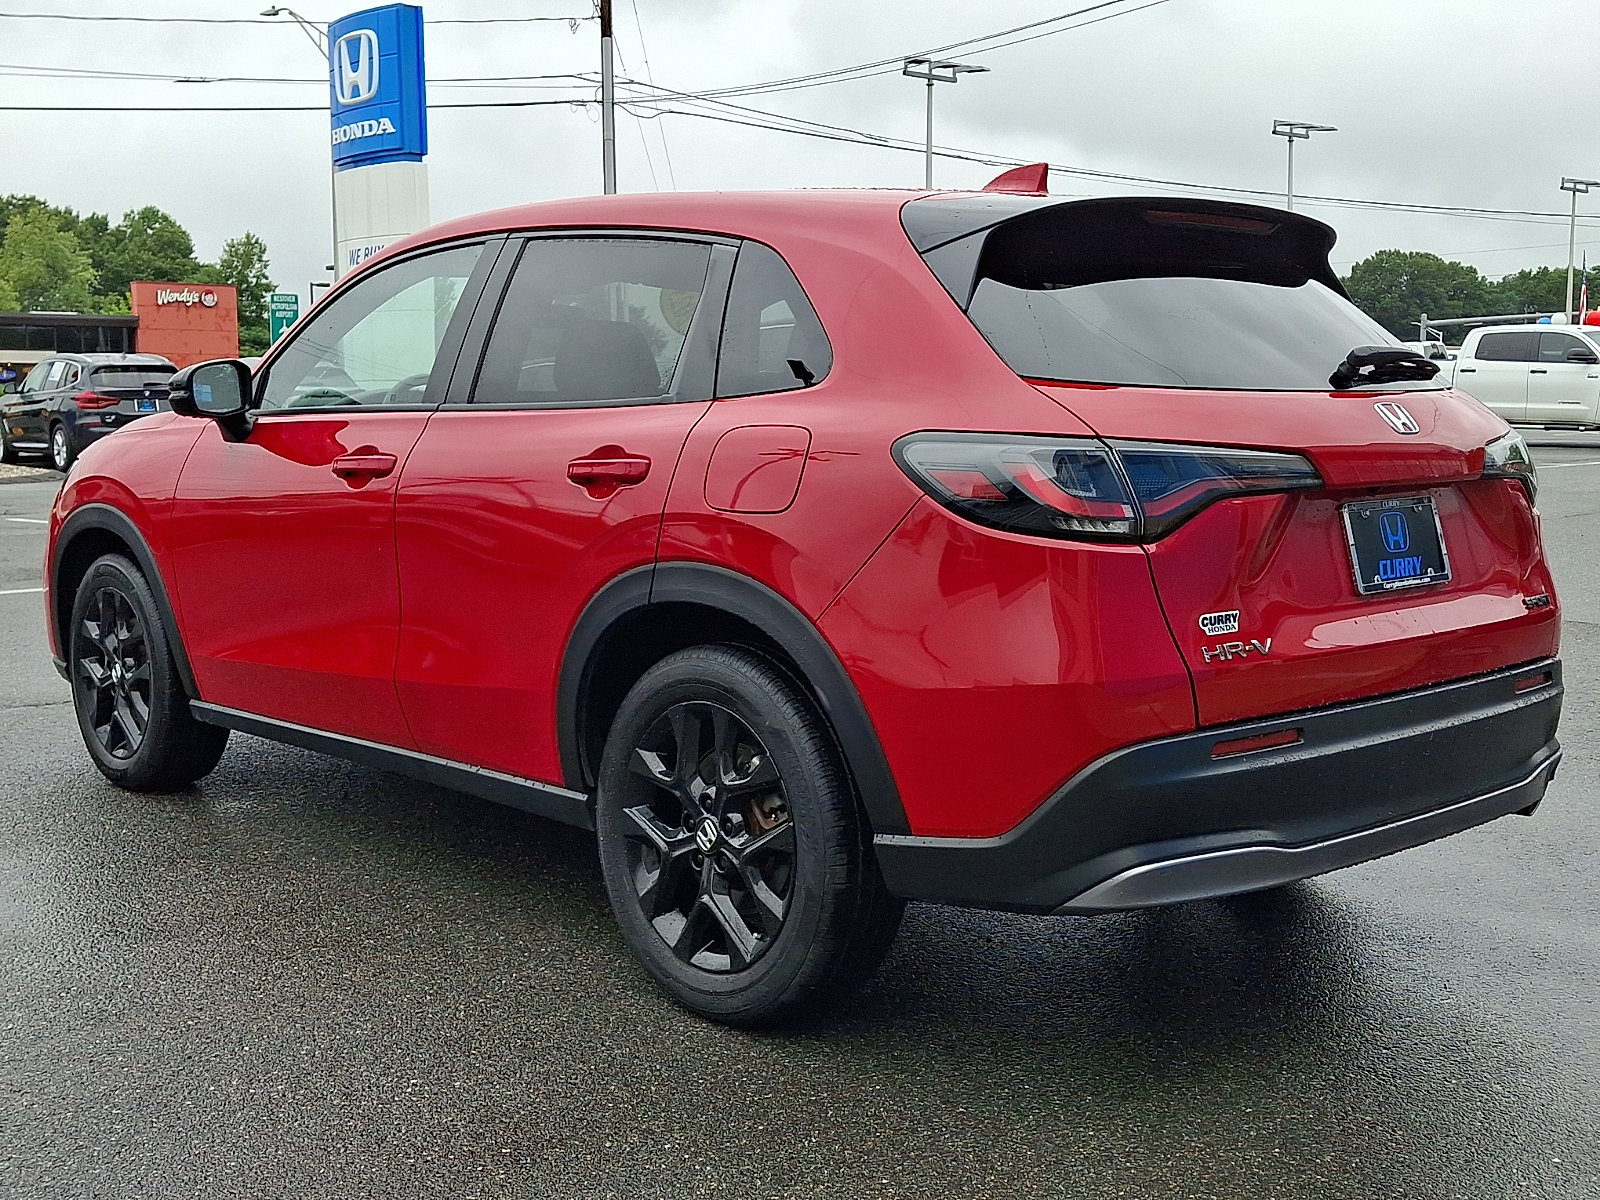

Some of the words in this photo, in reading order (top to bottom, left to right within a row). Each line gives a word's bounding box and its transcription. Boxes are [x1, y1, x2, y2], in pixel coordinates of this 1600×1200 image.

[331, 117, 397, 145] HONDA
[349, 248, 361, 266] WE
[157, 288, 200, 306] Wendy's
[1379, 556, 1422, 580] CURRY
[1201, 612, 1239, 628] CURRY
[1207, 624, 1237, 634] HONDA
[1201, 637, 1272, 663] HR-V
